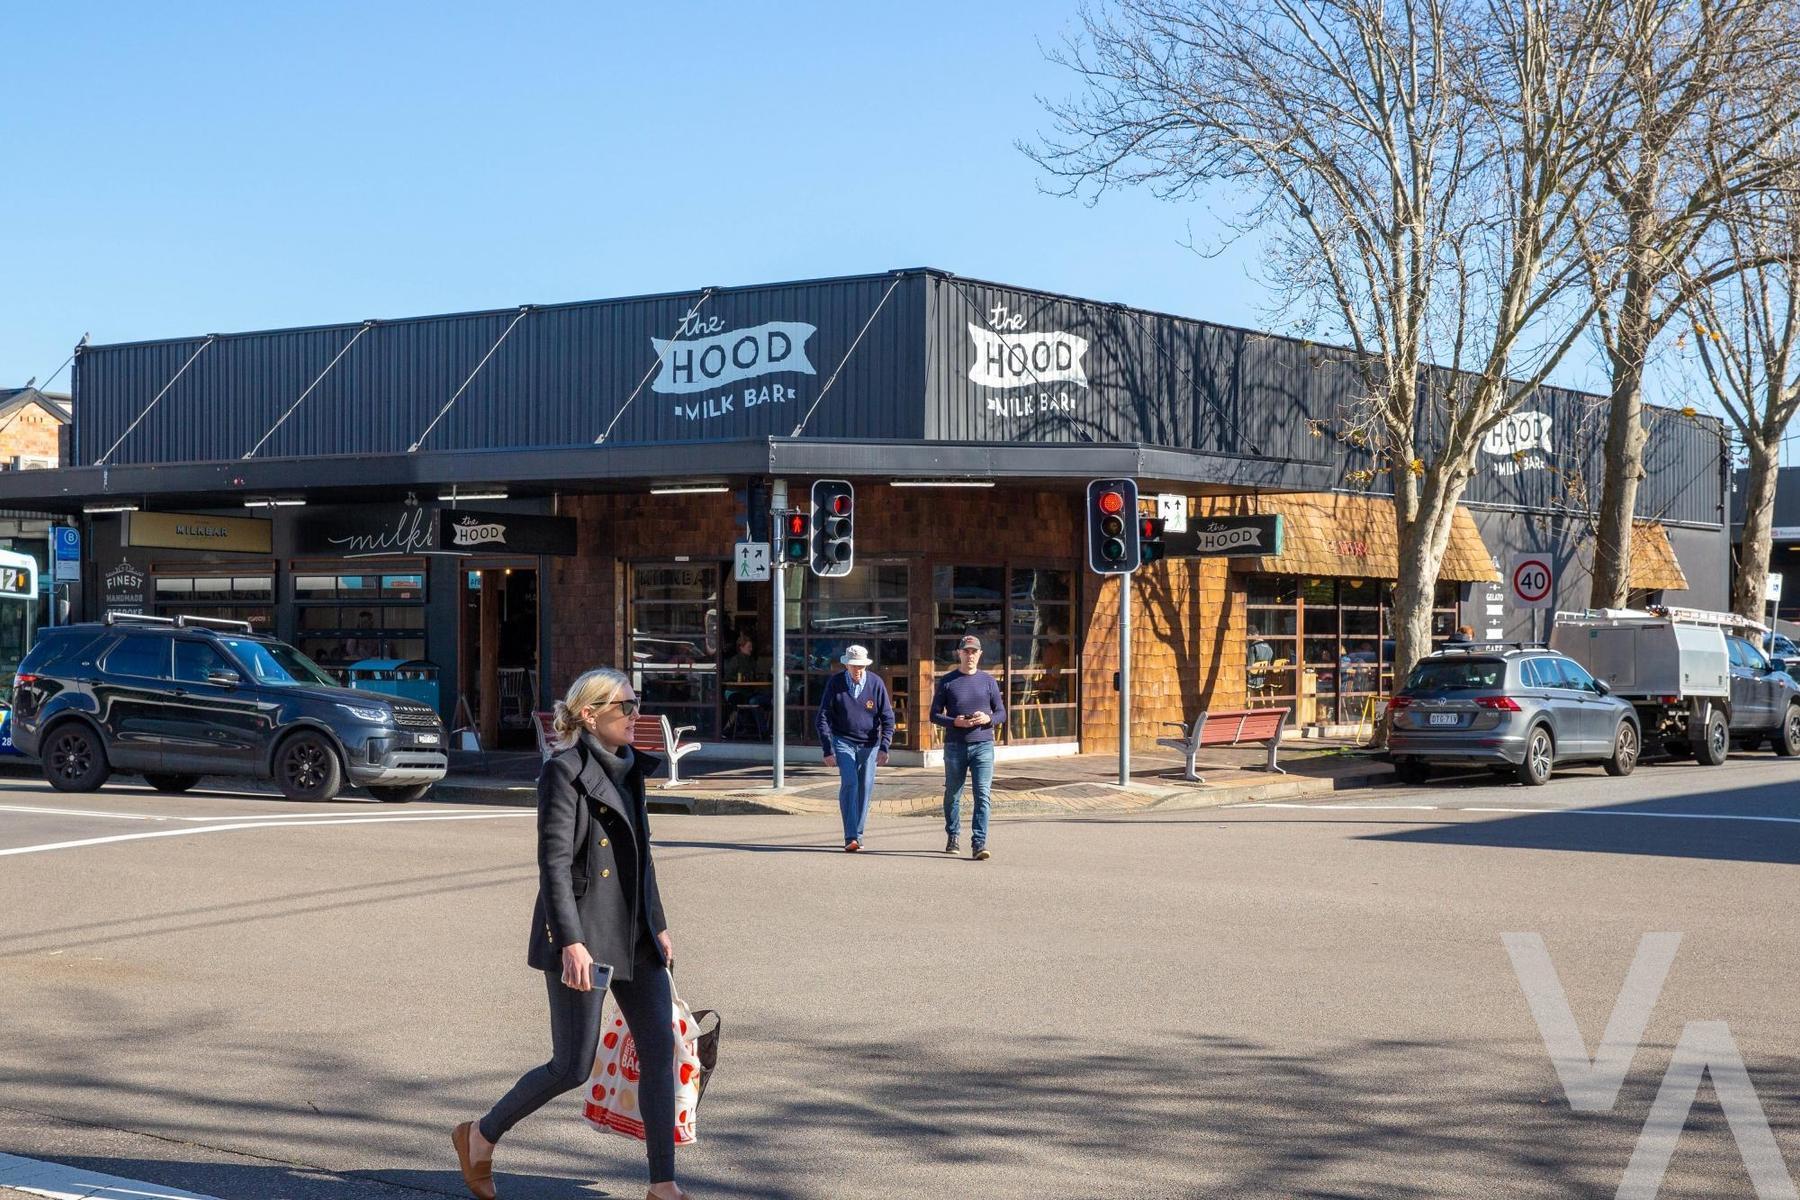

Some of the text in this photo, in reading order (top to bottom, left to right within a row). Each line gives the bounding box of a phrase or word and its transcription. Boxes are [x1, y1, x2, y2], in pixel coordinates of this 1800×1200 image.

[678, 309, 725, 336] the
[990, 302, 1027, 330] the
[673, 331, 792, 384] HOOD
[987, 341, 1072, 378] HOOD
[685, 384, 786, 421] MILK BAR
[1040, 392, 1069, 411] BAR
[1492, 418, 1542, 447] HOOD
[461, 516, 479, 525] the
[1207, 522, 1228, 532] the
[176, 525, 229, 538] MILKBAR
[460, 528, 499, 541] HOOD
[1205, 530, 1252, 548] HOOD
[106, 575, 143, 589] FINEST
[1520, 572, 1545, 590] 40
[1486, 593, 1504, 601] GELATO
